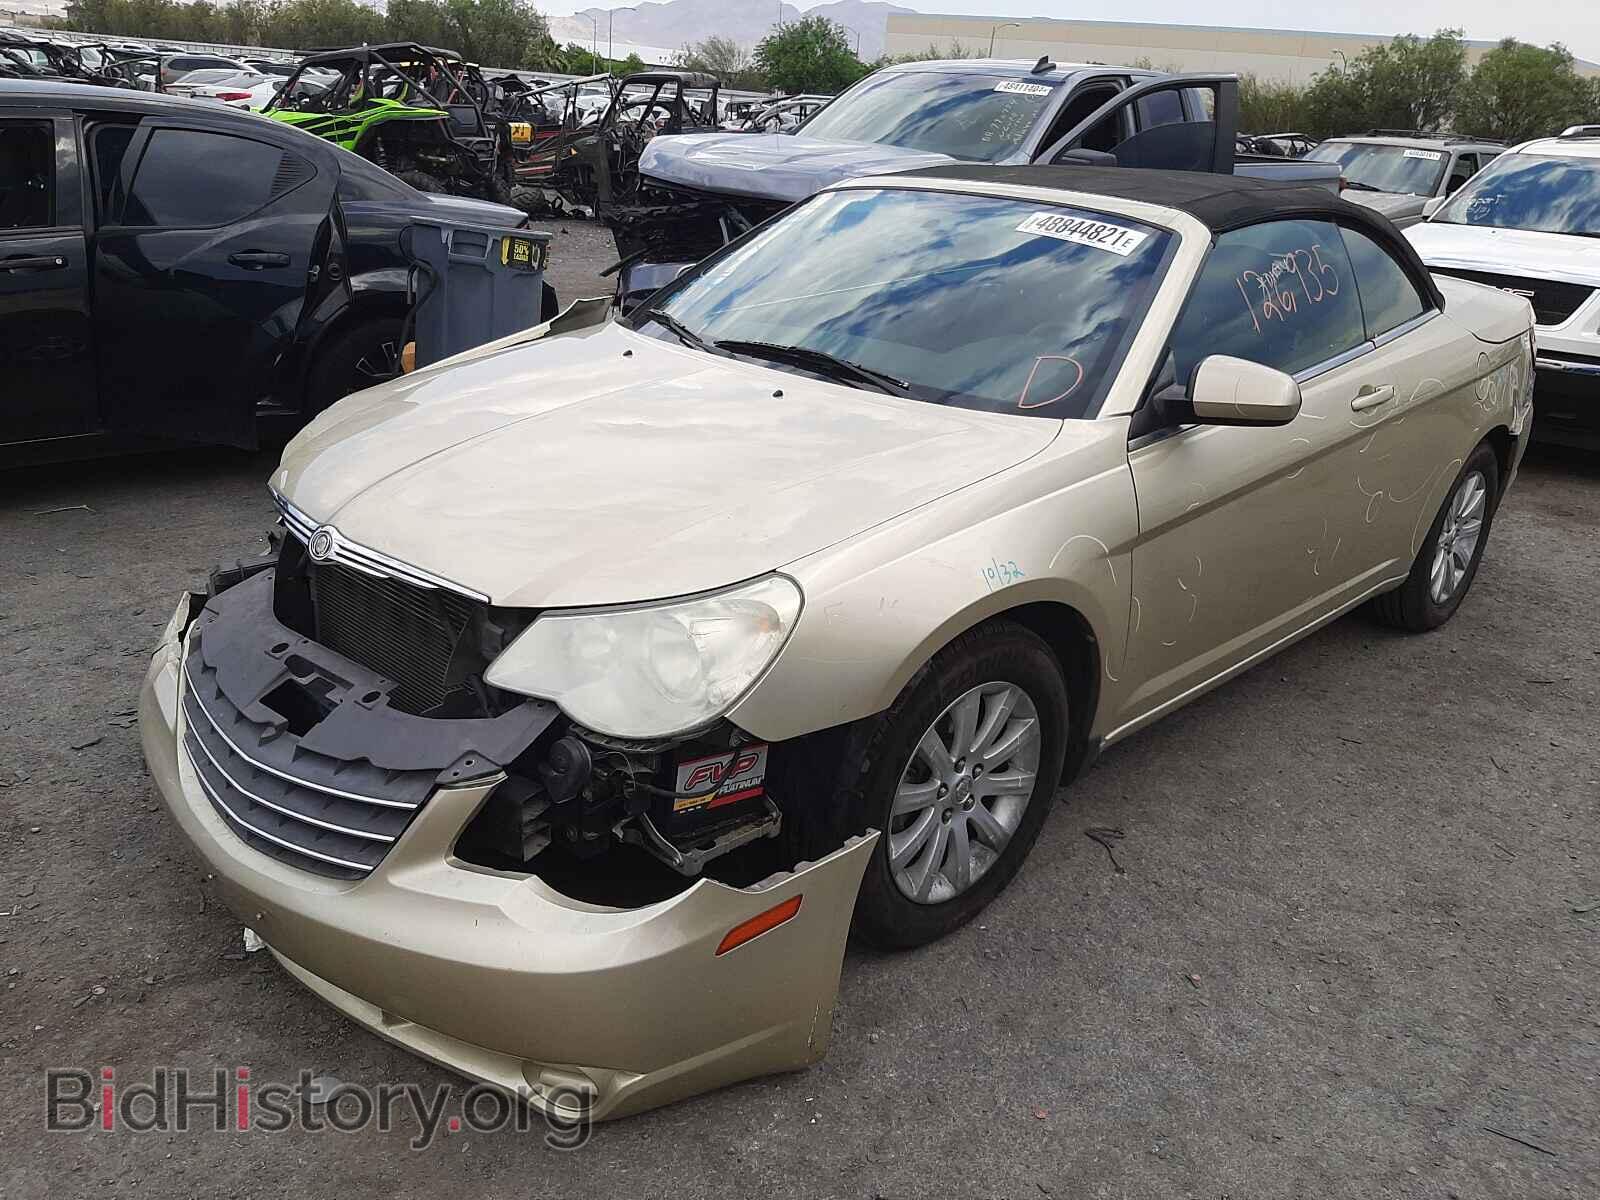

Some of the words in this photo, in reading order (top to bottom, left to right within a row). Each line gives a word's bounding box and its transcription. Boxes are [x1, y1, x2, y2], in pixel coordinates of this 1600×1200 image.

[1019, 354, 1084, 408] D
[981, 557, 1025, 593] 10/32
[684, 753, 760, 791] FVP
[718, 776, 765, 796] PLATINUM
